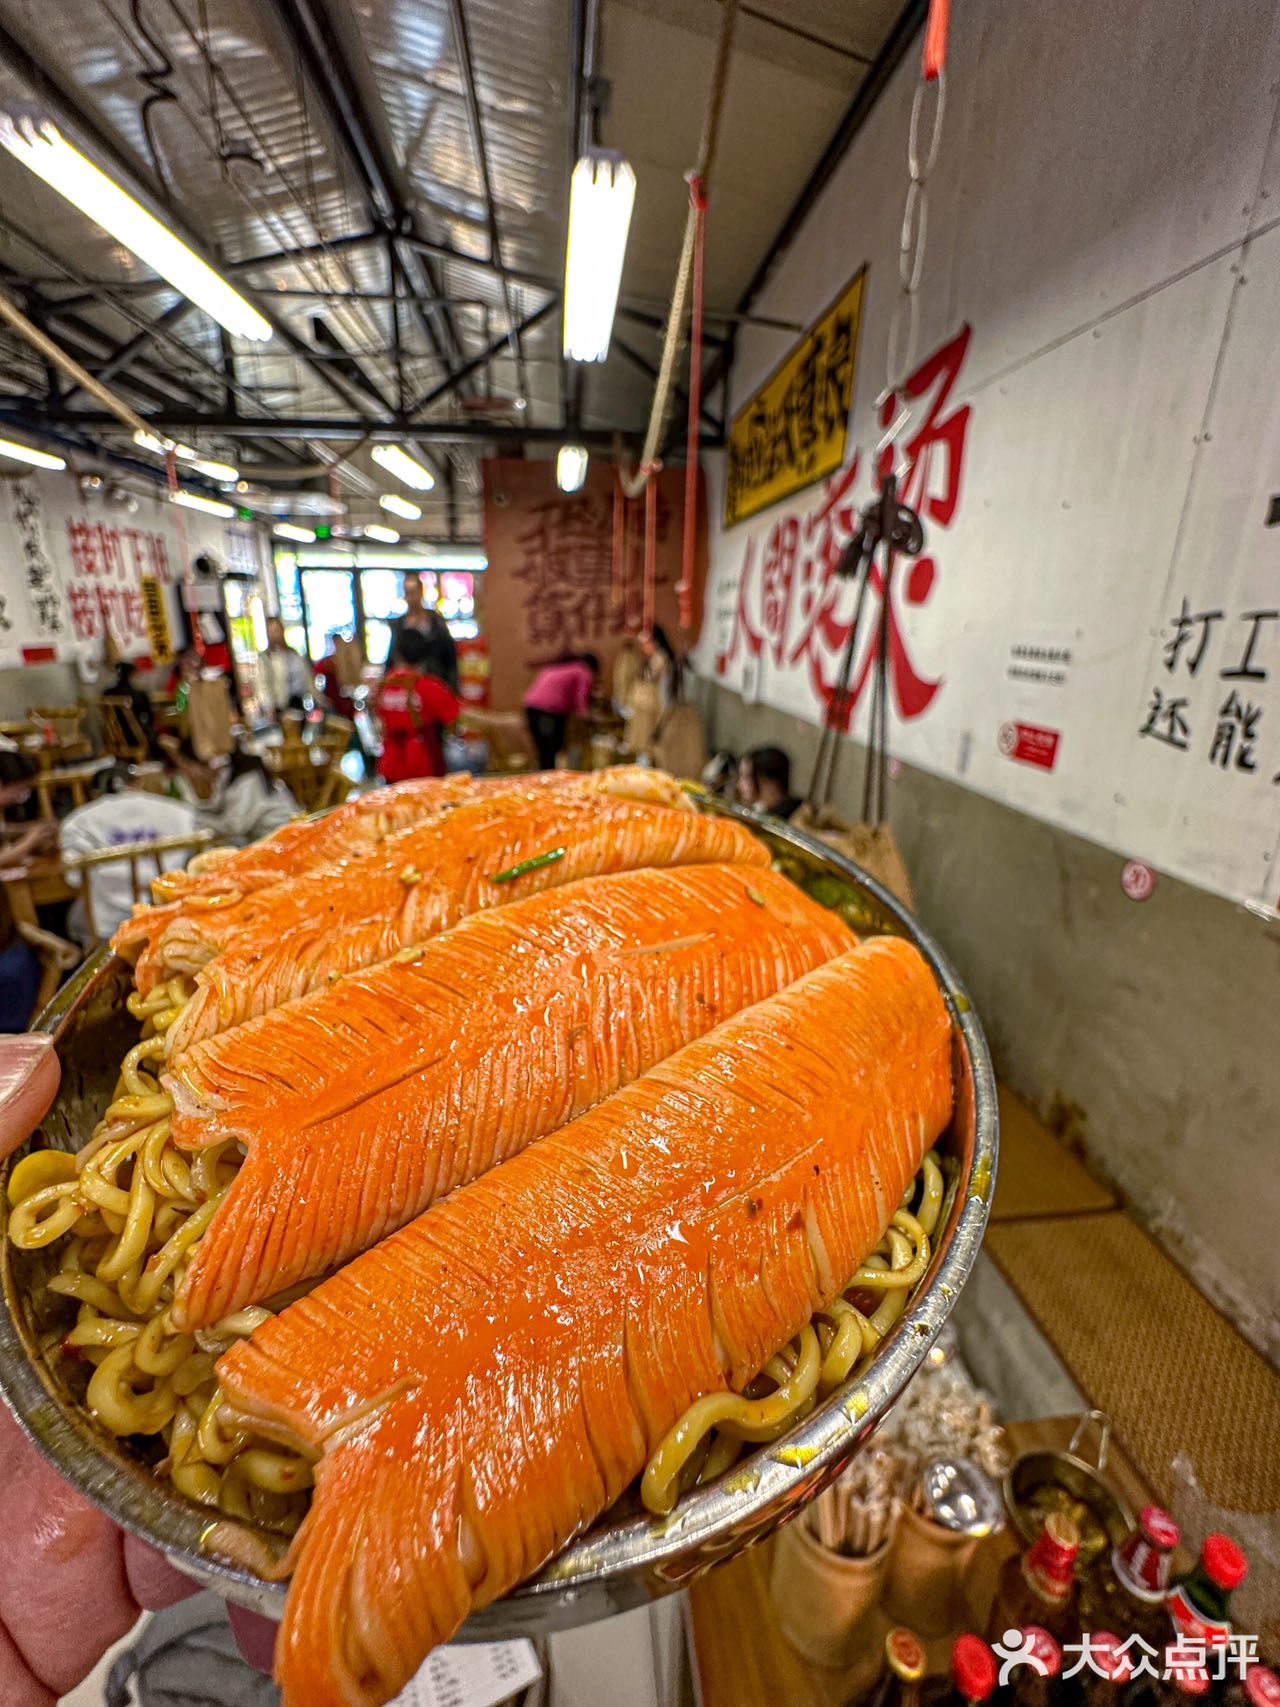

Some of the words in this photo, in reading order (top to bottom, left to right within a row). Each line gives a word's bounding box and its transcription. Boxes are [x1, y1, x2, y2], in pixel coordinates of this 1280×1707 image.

[66, 581, 148, 648] 按时吃
[1163, 596, 1280, 681] 打工
[1138, 687, 1280, 784] 还能
